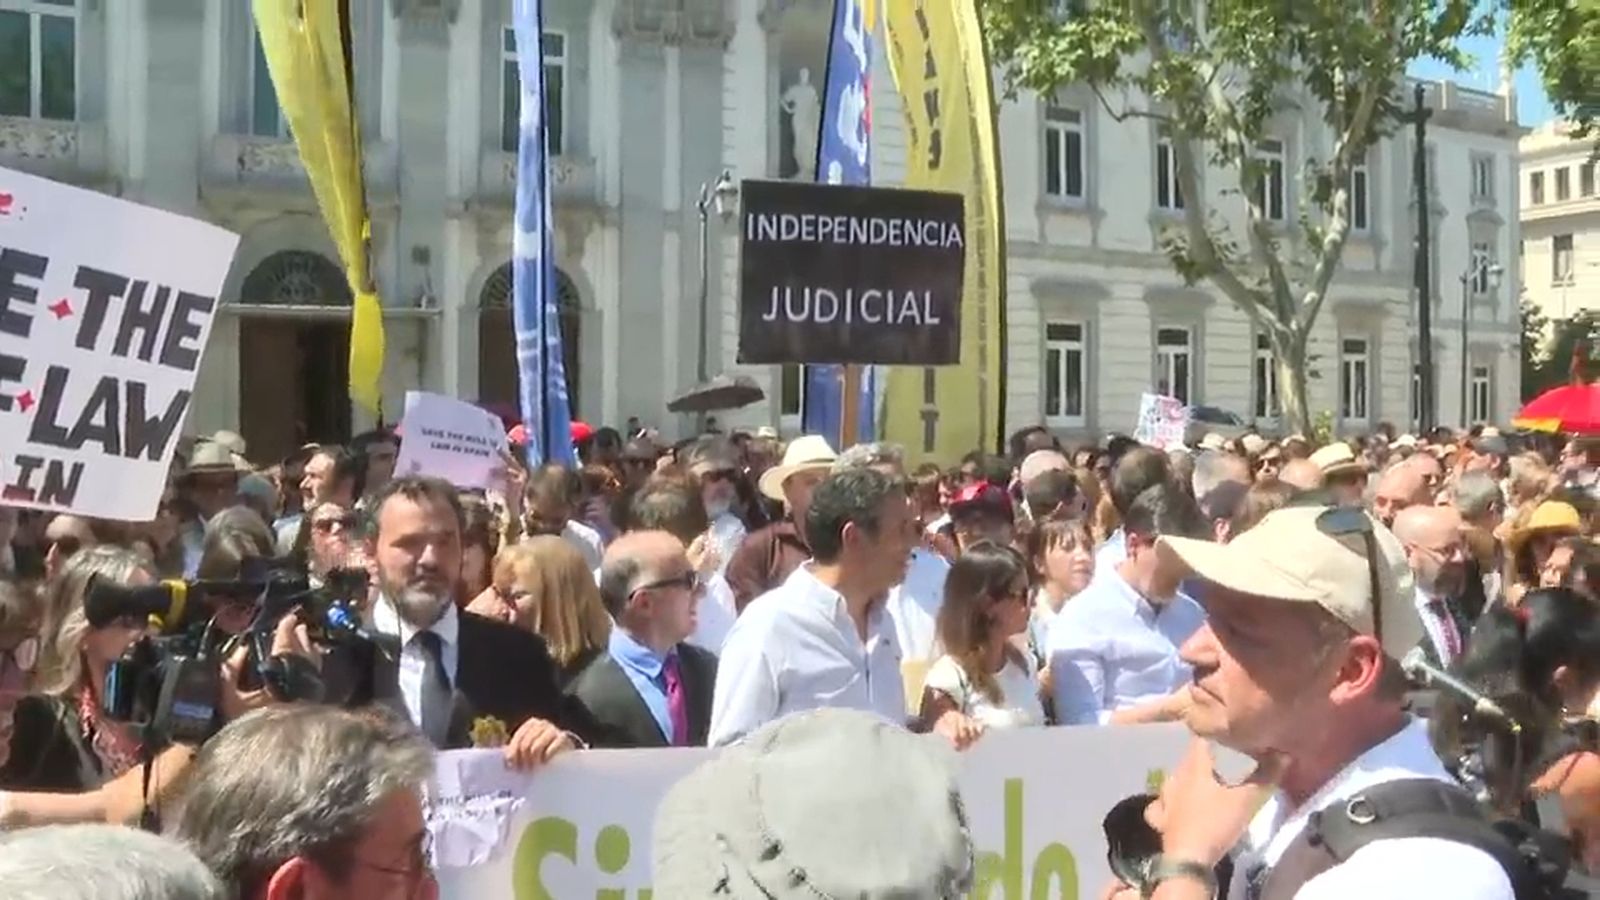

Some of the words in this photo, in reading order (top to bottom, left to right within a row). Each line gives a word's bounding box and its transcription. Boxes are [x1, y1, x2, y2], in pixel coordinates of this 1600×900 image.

[747, 212, 964, 248] INDEPENDENCIA
[73, 265, 216, 371] THE
[762, 285, 940, 325] JUDICIAL
[27, 365, 192, 462] LAW
[3, 454, 84, 507] IN
